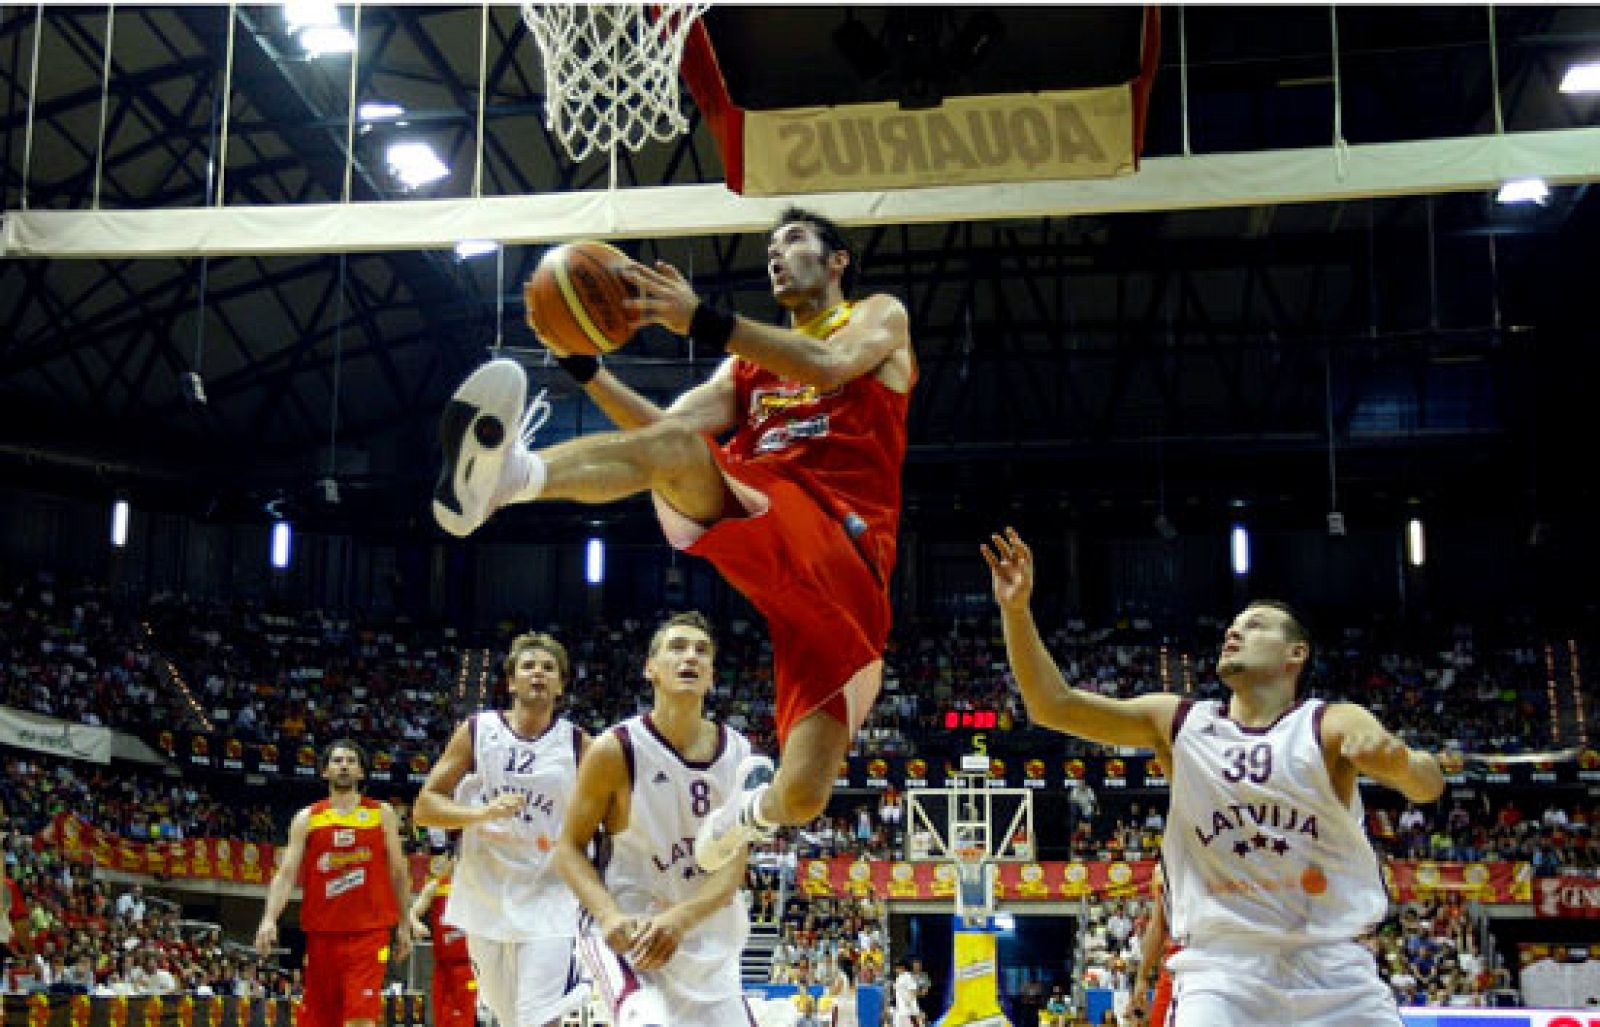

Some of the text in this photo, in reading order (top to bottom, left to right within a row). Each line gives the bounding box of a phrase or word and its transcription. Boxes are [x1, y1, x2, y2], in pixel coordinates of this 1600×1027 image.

[503, 747, 536, 775] 12
[1222, 743, 1273, 783] 39
[690, 780, 711, 818] 8
[1195, 802, 1319, 847] LATVIJA
[651, 836, 697, 874] LAT
